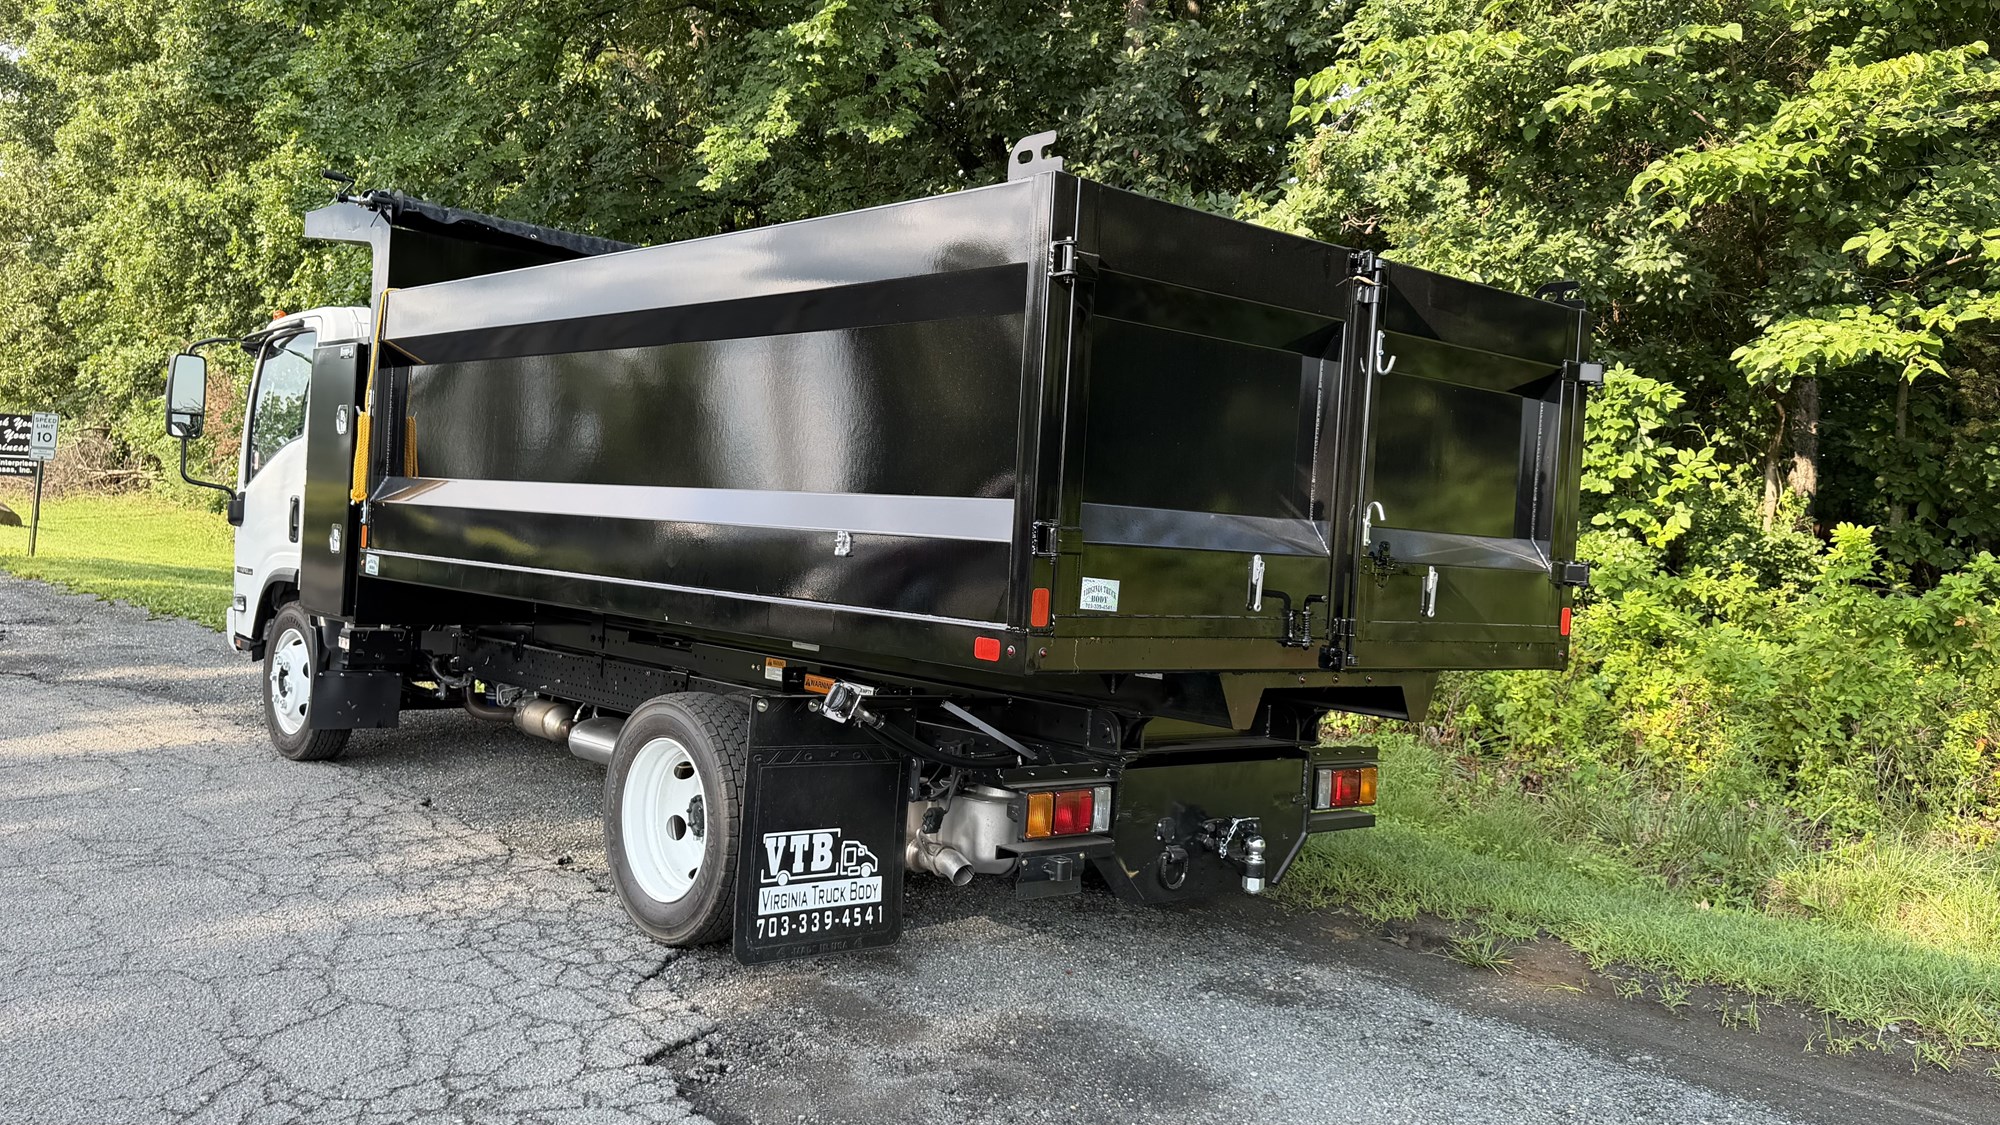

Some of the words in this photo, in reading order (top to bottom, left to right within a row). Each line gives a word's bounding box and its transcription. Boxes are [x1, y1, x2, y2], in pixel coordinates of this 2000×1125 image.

[13, 416, 32, 431] You
[3, 428, 31, 443] Your
[37, 432, 52, 443] 10
[0, 459, 38, 467] nterprises
[1091, 595, 1108, 603] BODY
[765, 833, 834, 876] VTB
[762, 890, 808, 911] VIRGINIA
[812, 885, 847, 905] TRUCK
[850, 881, 879, 901] BODY
[756, 905, 883, 939] 703-339-4541
